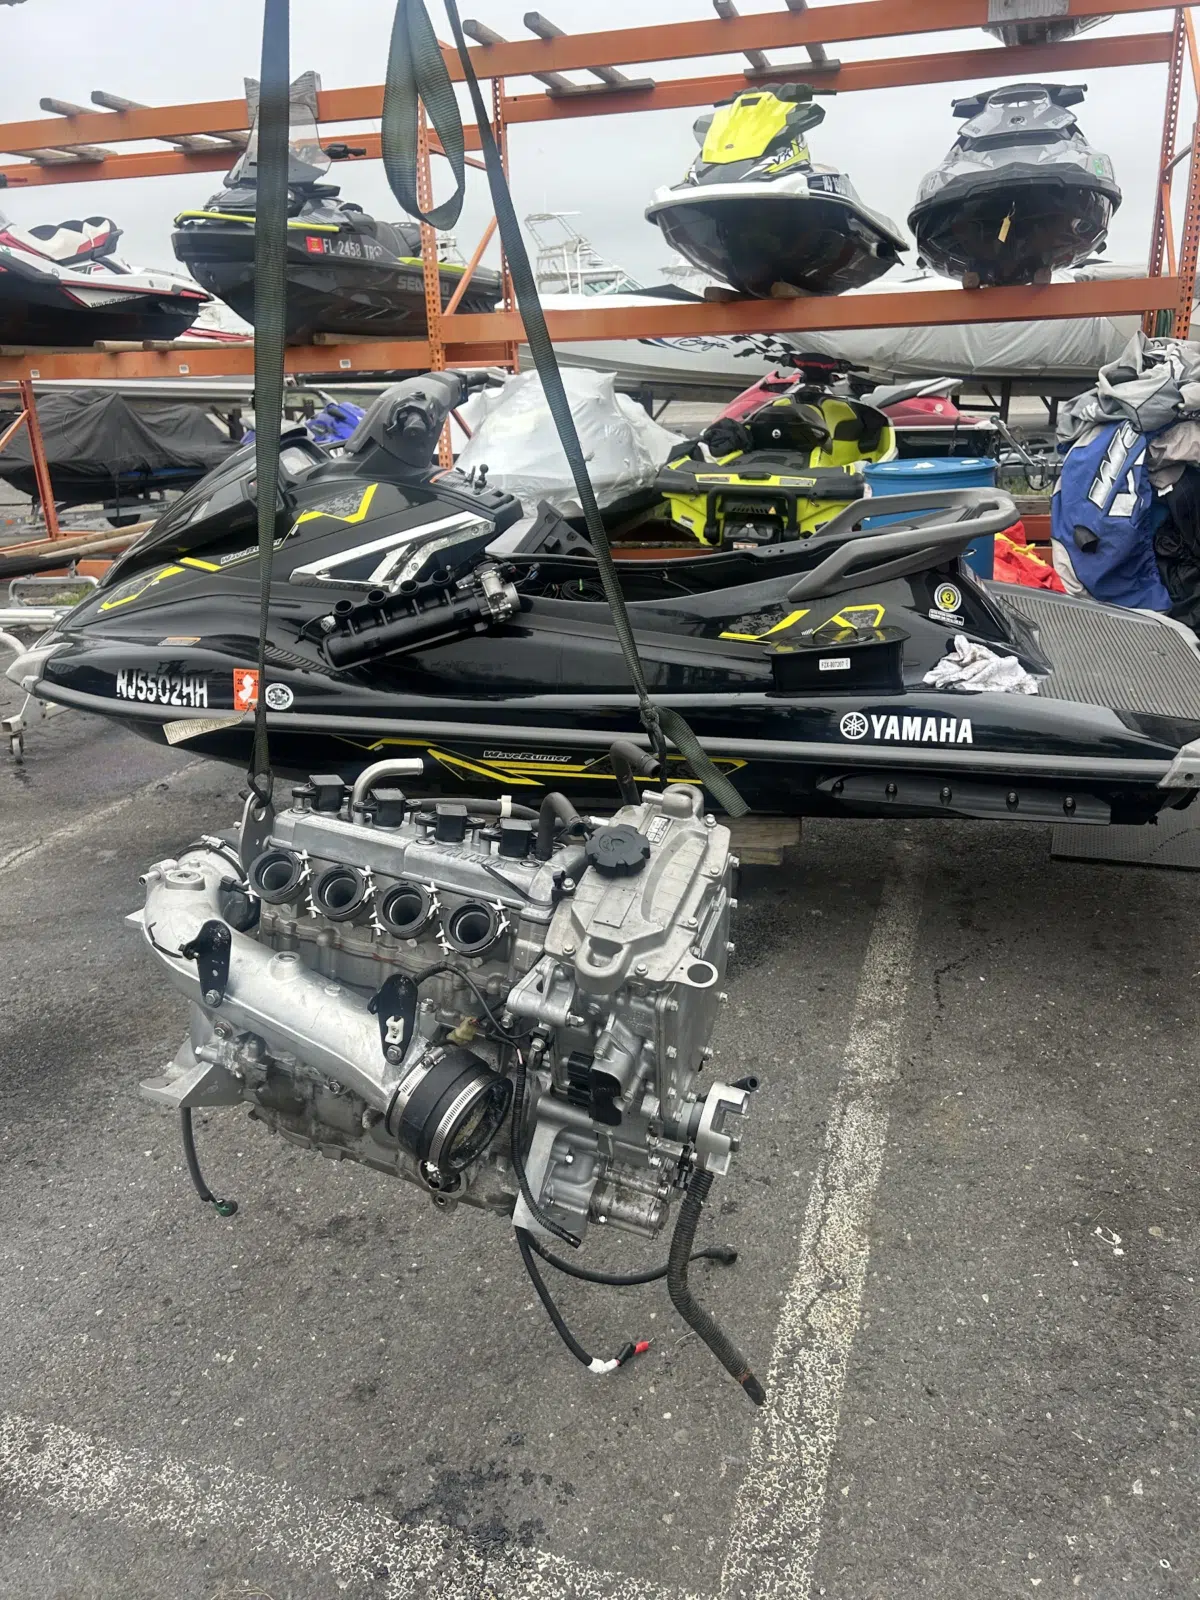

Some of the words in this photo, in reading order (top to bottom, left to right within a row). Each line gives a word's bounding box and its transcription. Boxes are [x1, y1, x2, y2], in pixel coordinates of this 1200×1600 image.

[322, 238, 335, 254] FL
[337, 240, 362, 262] 2458
[945, 592, 952, 602] 3
[116, 668, 208, 709] NJ5502HH
[870, 714, 974, 744] YAMAHA
[483, 750, 572, 763] WaveRunner
